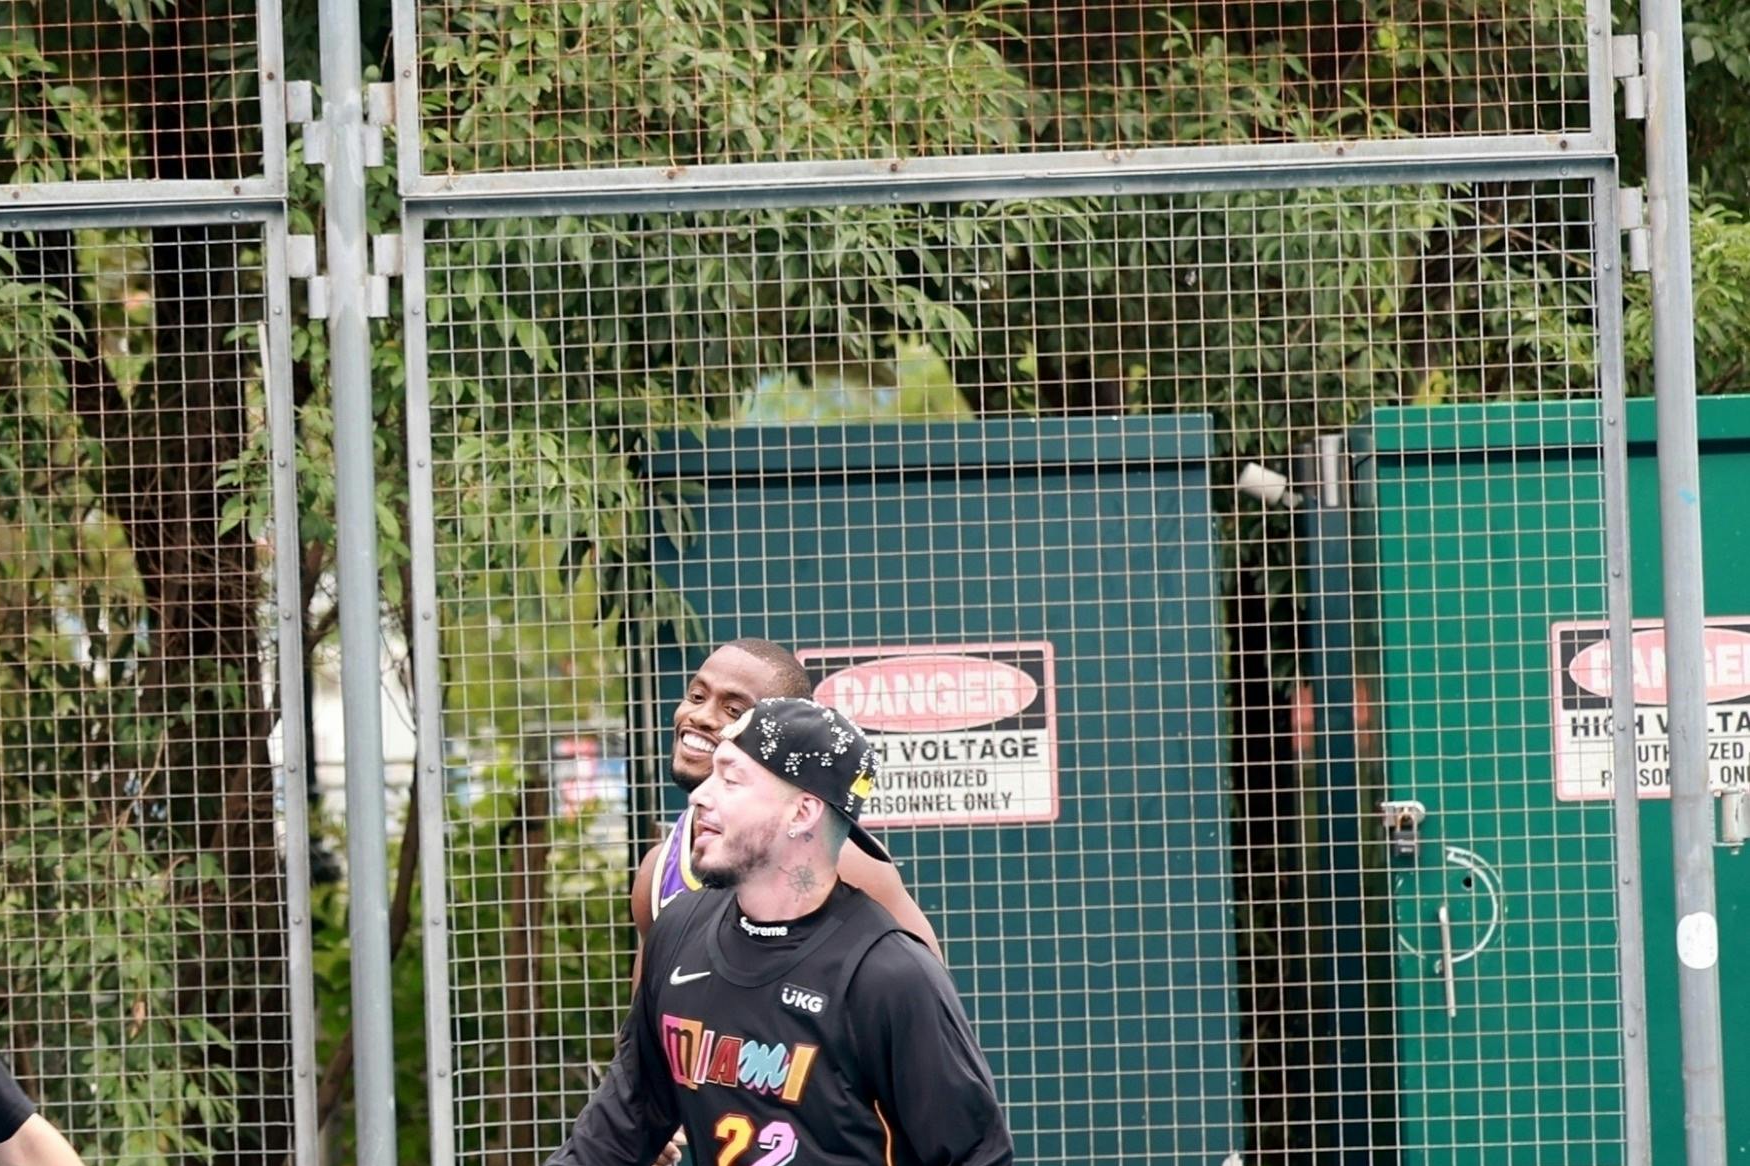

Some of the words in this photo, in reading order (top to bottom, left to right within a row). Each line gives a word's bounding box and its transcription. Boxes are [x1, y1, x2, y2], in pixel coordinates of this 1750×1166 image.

[1590, 644, 1750, 690] DANE
[833, 671, 1016, 717] DANGER
[1656, 711, 1750, 735] VTA
[899, 736, 1039, 762] VOLTAGE
[860, 794, 956, 815] ERSONNEL
[964, 791, 1012, 811] ONLY
[739, 915, 789, 937] Supreme
